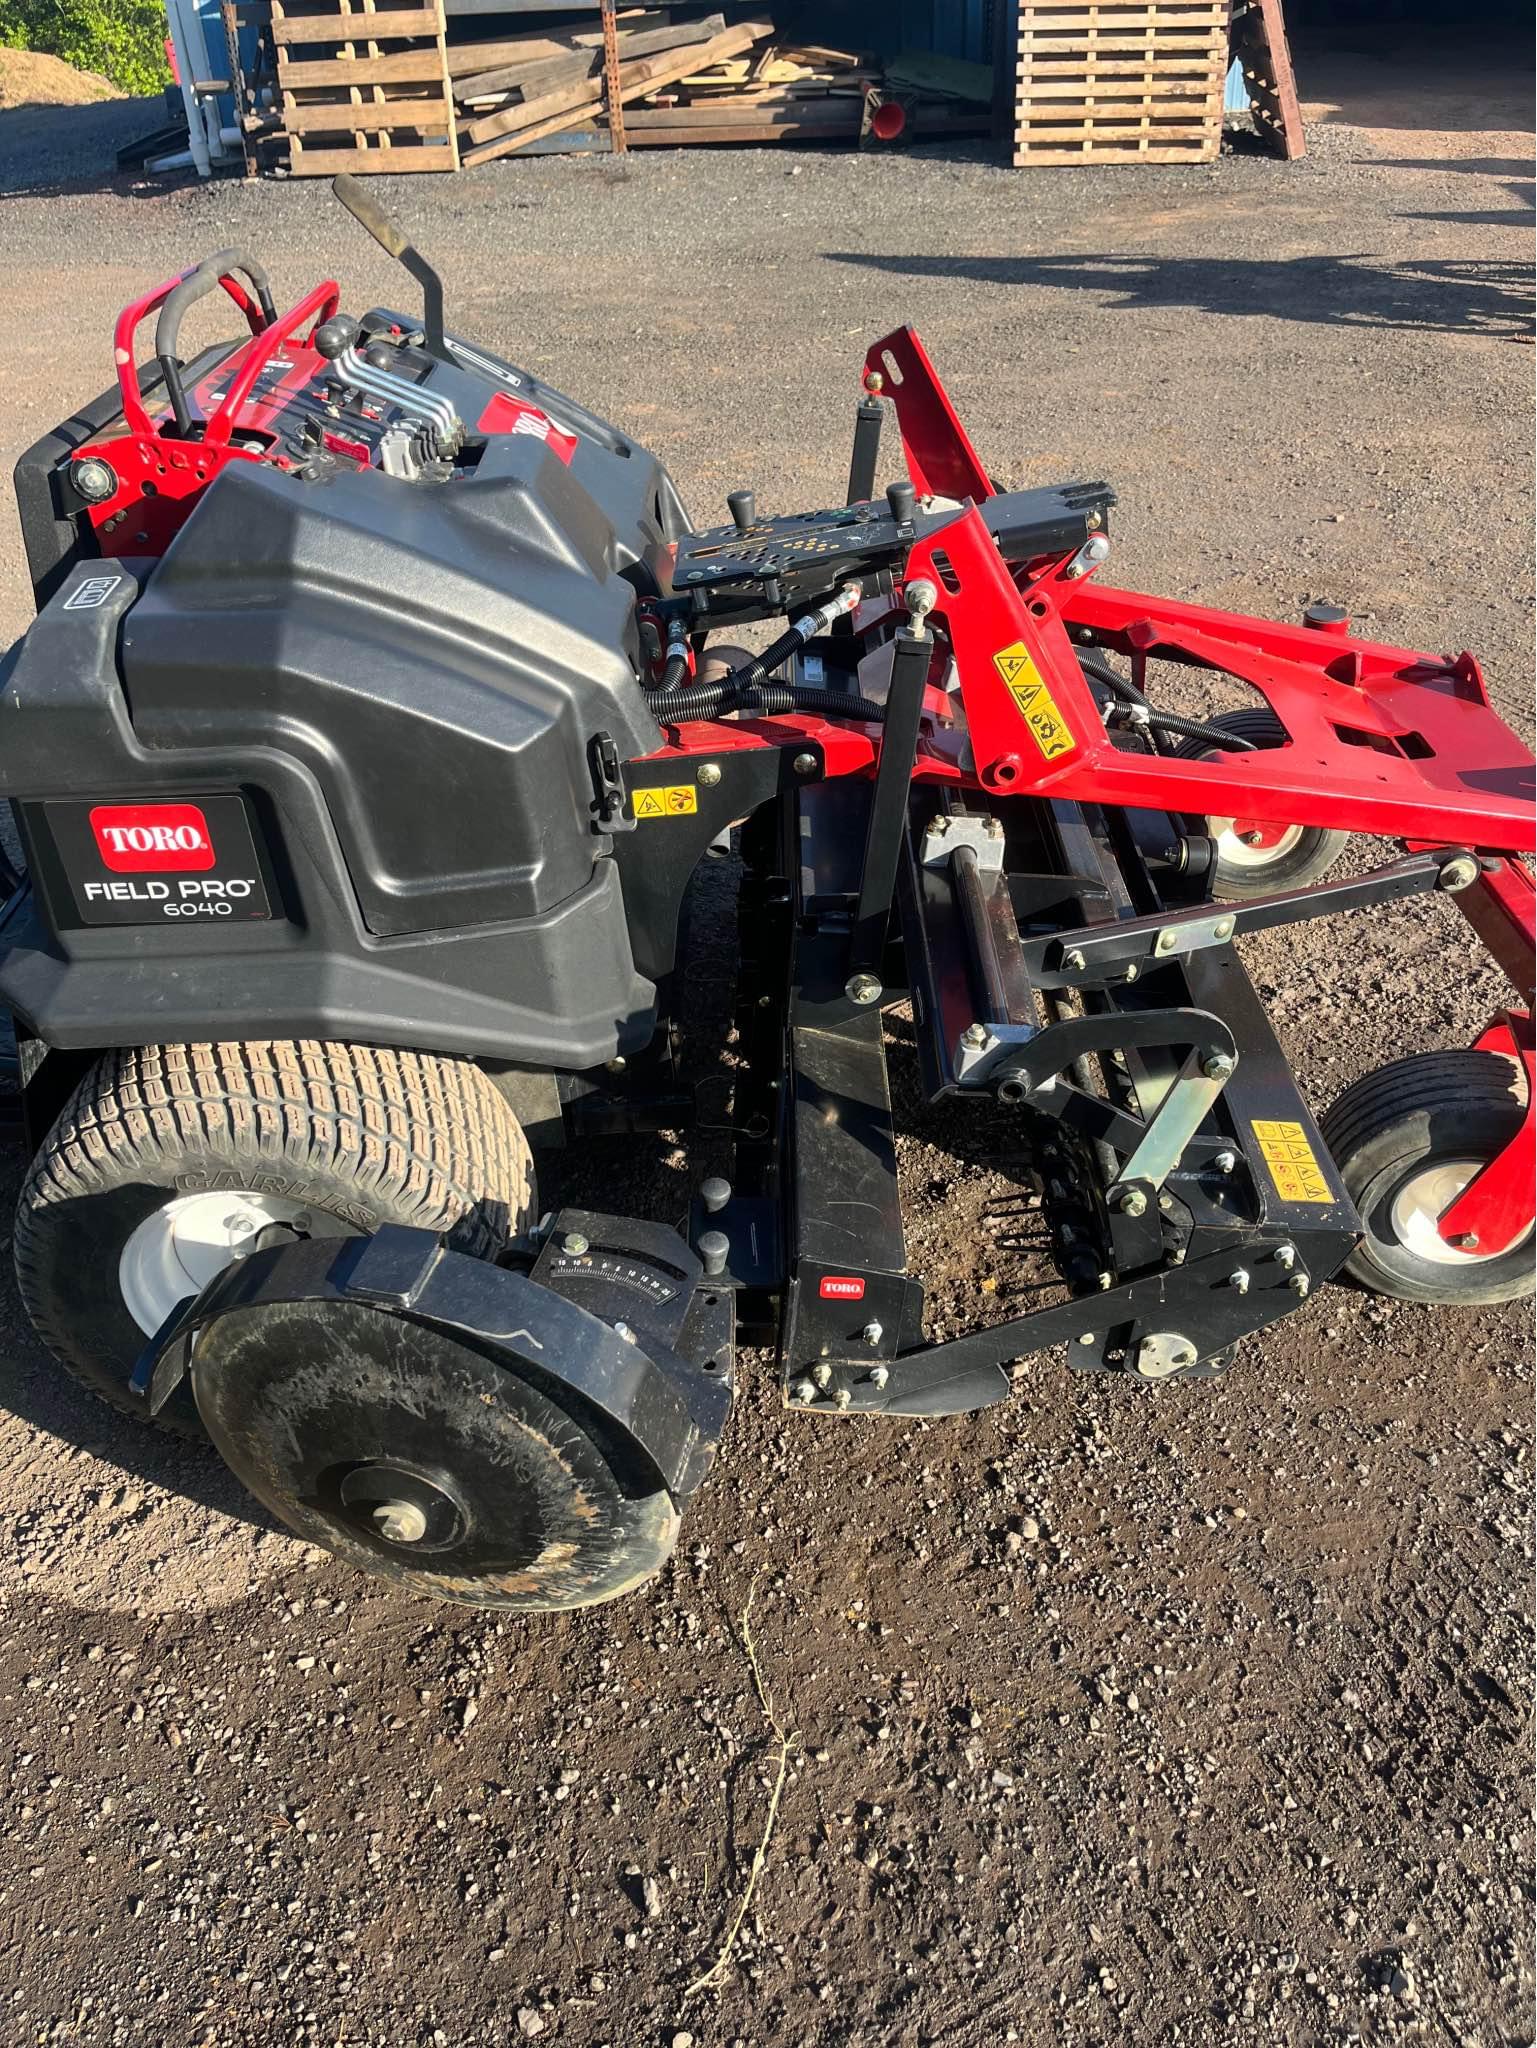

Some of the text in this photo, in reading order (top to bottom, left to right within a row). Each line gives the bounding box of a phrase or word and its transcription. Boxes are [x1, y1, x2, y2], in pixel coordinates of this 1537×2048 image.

[102, 825, 203, 852] TORO
[83, 881, 170, 901] FIELD
[163, 902, 233, 916] 6040
[173, 1169, 377, 1229] CARLIS
[823, 1282, 861, 1293] TORO
